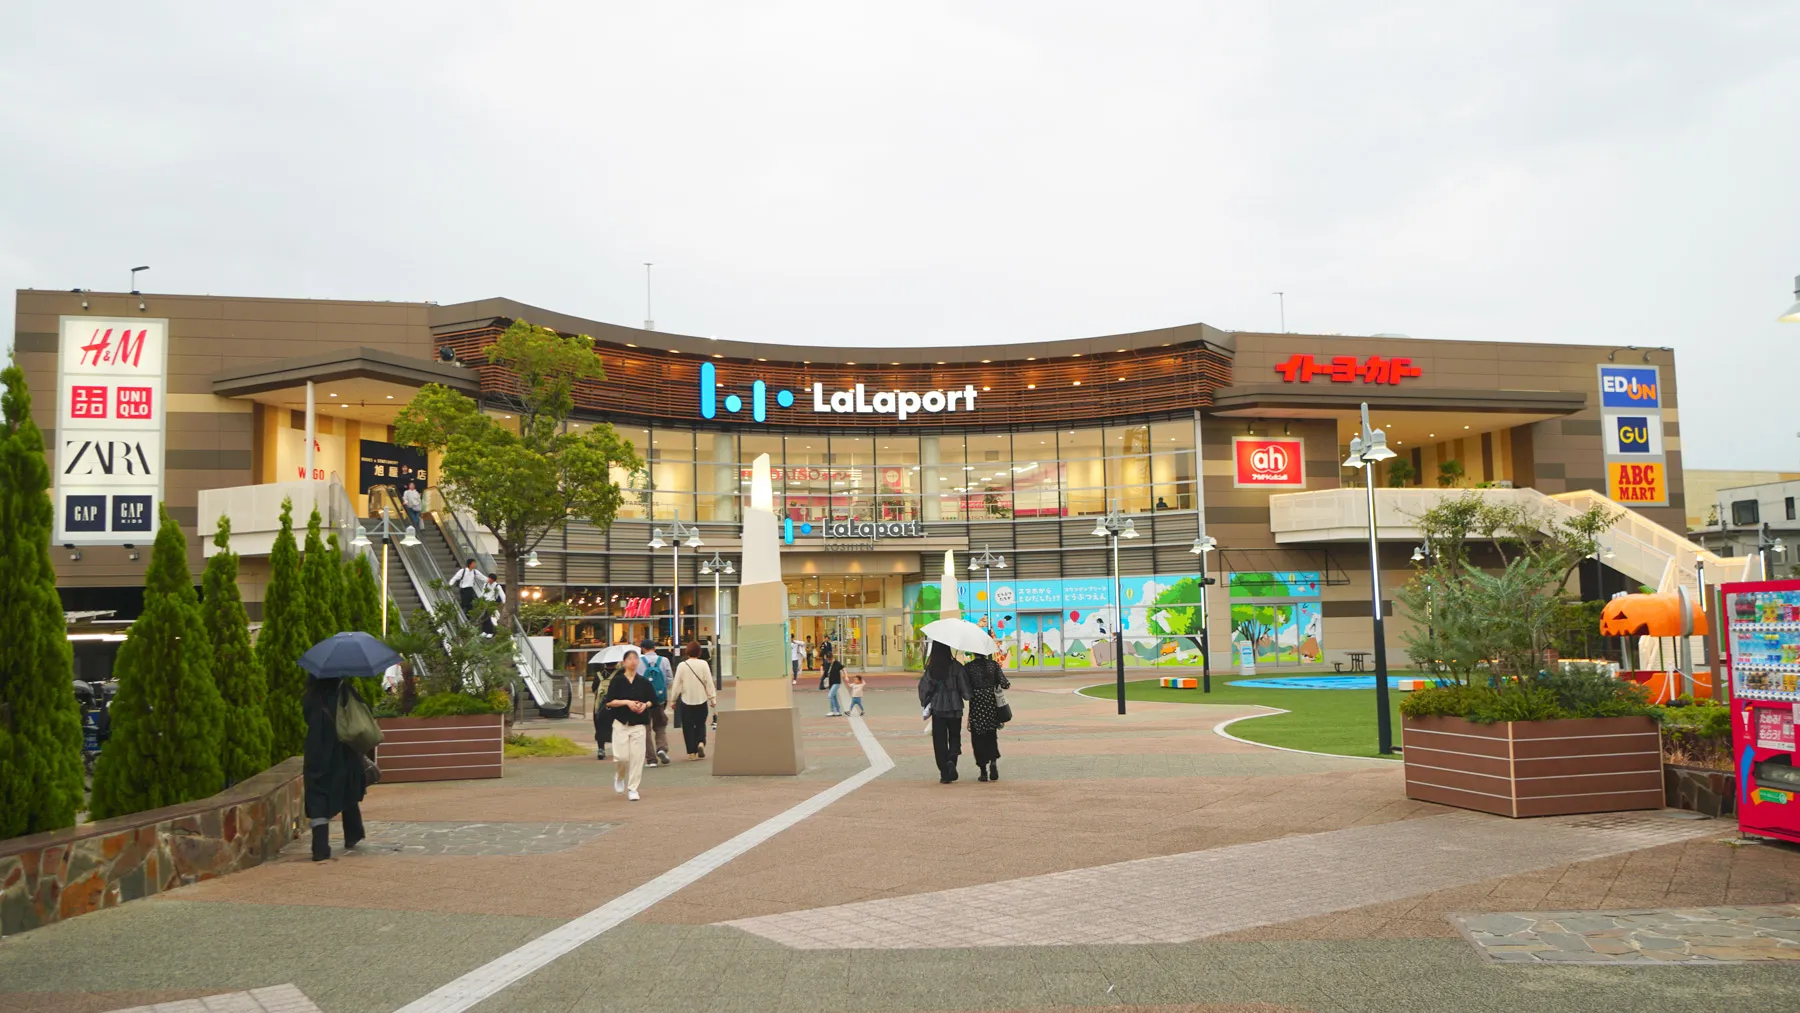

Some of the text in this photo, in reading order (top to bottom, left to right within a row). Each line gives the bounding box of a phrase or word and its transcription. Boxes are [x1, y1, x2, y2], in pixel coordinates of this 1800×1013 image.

[80, 328, 147, 368] H&M
[1275, 354, 1422, 385] イトーヨーカドー
[75, 390, 103, 401] ユニ
[120, 390, 146, 402] UNI
[1603, 376, 1657, 400] EDION
[75, 403, 103, 415] クロ
[119, 403, 148, 416] QLO
[813, 382, 978, 421] LaLaport
[1619, 426, 1648, 444] GU
[64, 441, 152, 475] ZARA
[1253, 446, 1284, 469] ah
[298, 467, 325, 481] WGO
[374, 464, 427, 481] 旭屋店
[1618, 465, 1655, 485] ABC
[1619, 487, 1656, 500] MART
[74, 506, 97, 521] GAP
[121, 503, 144, 518] GAP
[823, 518, 921, 541] LaLaport
[825, 543, 874, 552] KOSHIEN
[624, 597, 653, 618] H&M
